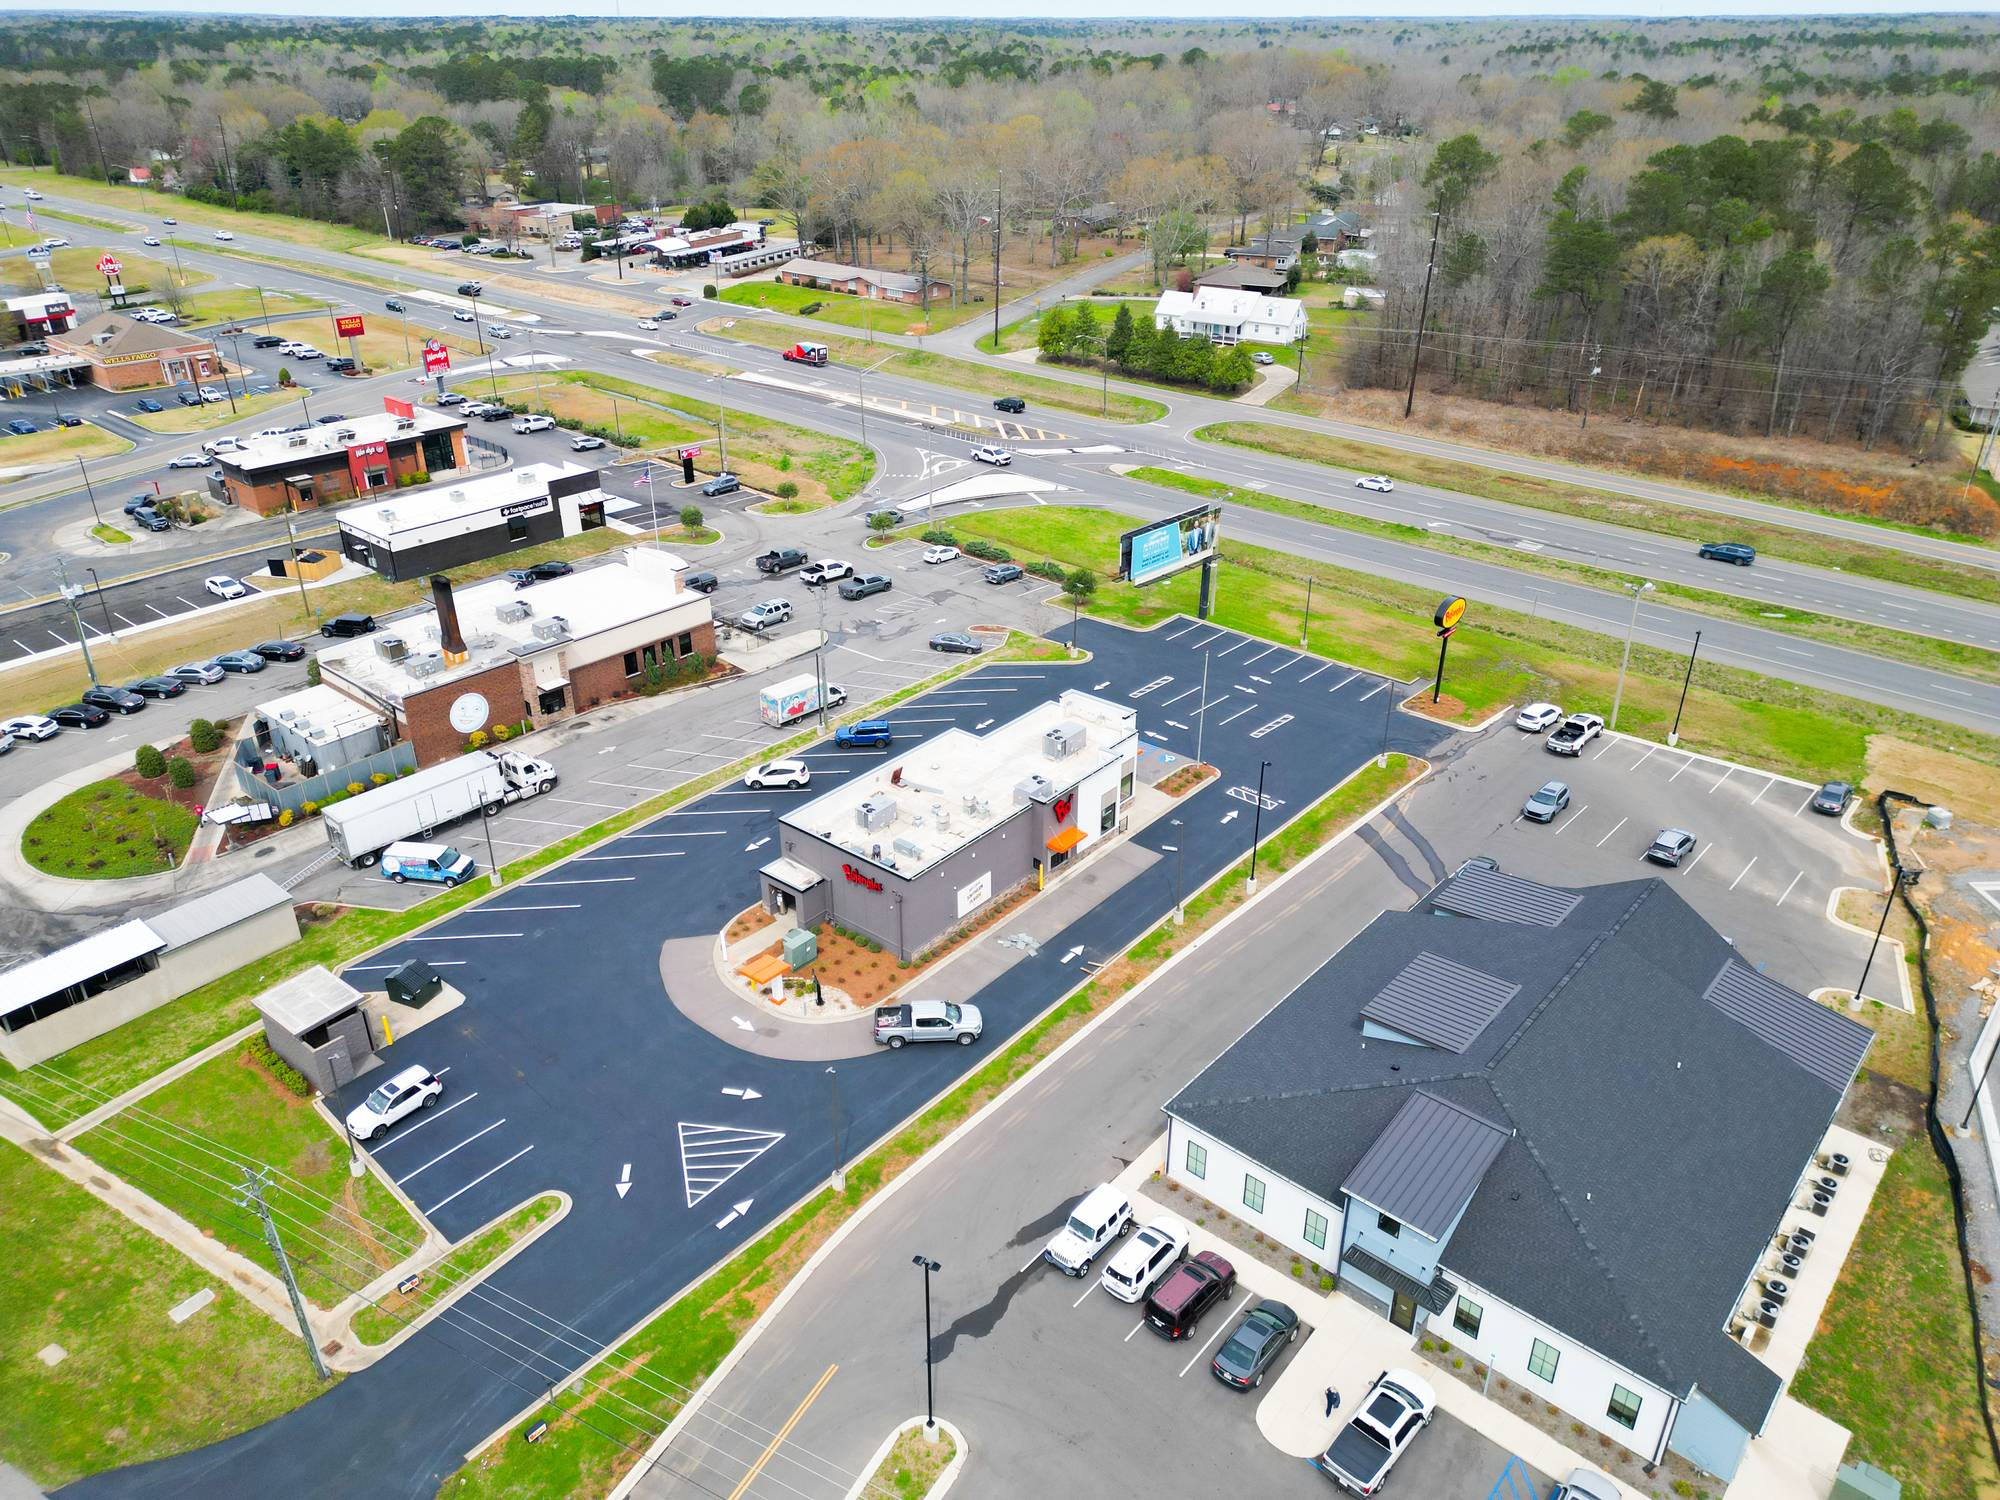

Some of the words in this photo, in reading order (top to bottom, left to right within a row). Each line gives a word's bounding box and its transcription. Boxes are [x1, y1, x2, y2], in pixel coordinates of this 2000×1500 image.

[103, 356, 131, 365] WELLS
[131, 352, 156, 361] FARGO
[841, 863, 883, 892] Bojangles
